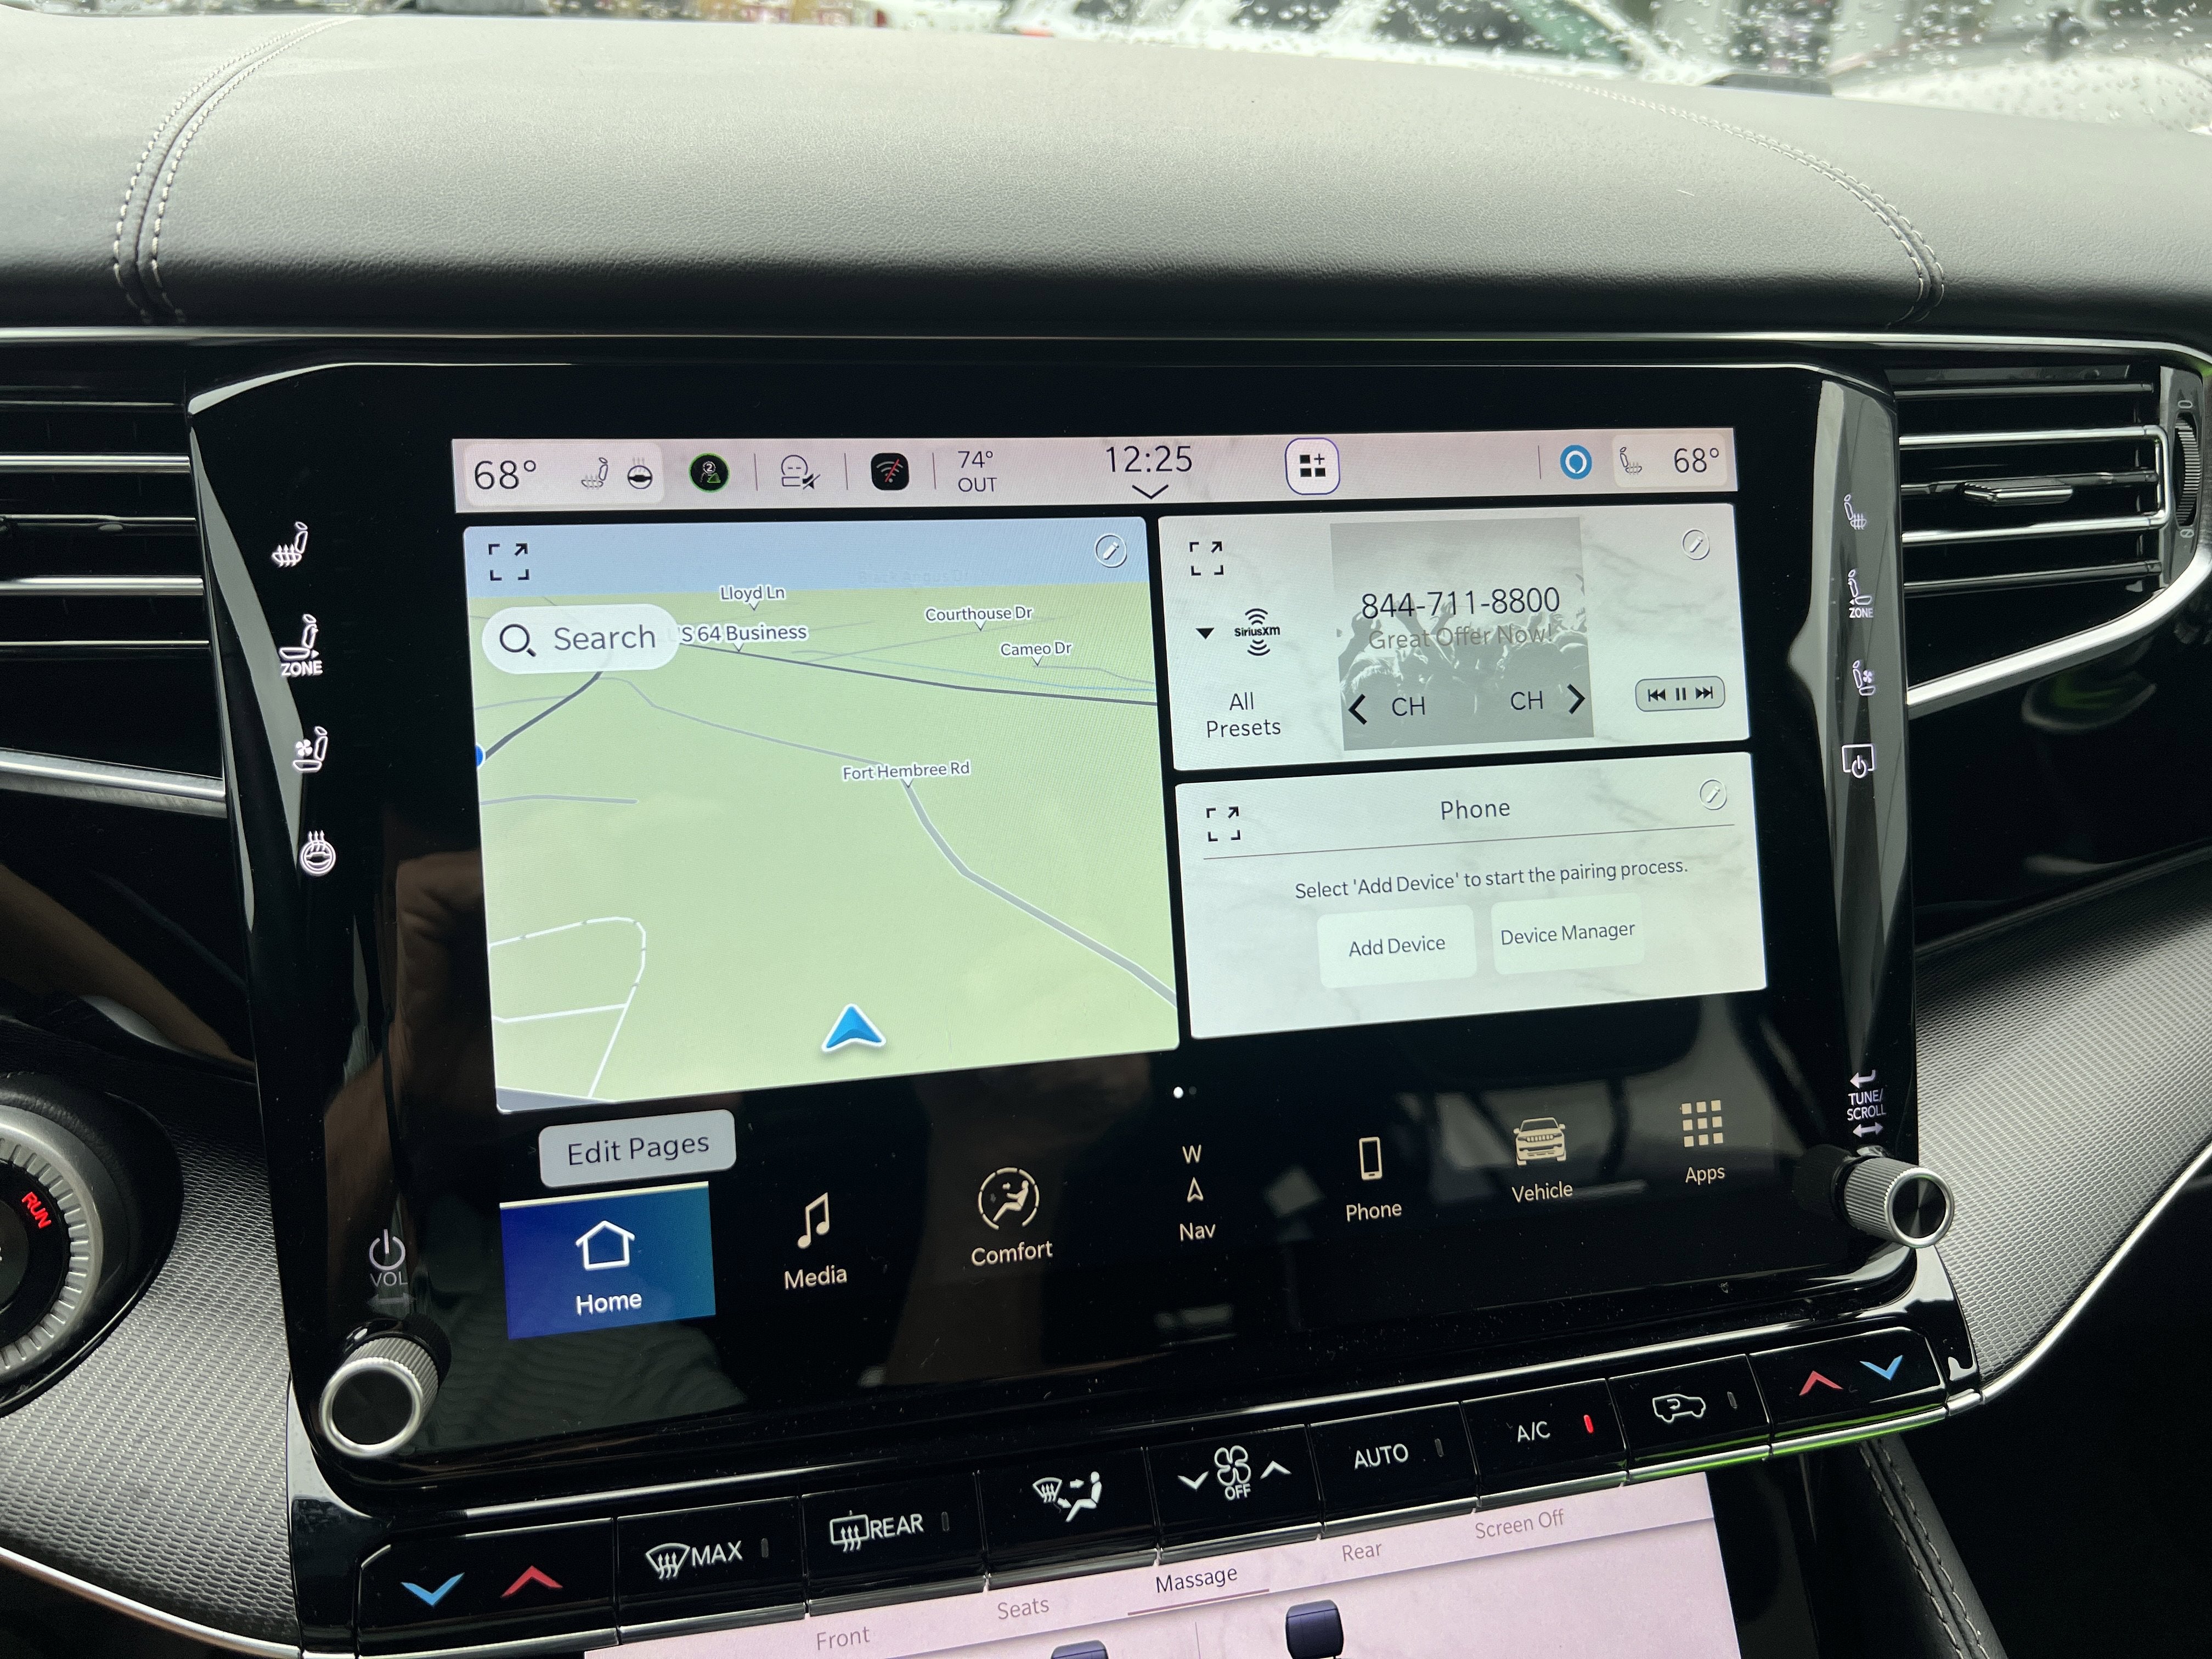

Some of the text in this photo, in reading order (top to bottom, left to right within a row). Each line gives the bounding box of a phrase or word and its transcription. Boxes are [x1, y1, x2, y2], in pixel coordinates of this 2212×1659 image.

[957, 450, 994, 469] 74°
[1105, 445, 1193, 473] 12:25
[1673, 447, 1720, 473] 68°
[473, 460, 537, 490] 68°
[957, 476, 997, 493] OUT
[720, 585, 785, 602] Lloyd Ln
[1361, 586, 1560, 619] 844-711-8800
[926, 606, 1032, 622] Courthouse Dr
[1849, 607, 1874, 618] ZONE
[554, 624, 656, 651] Search
[697, 625, 721, 642] 64
[727, 624, 807, 641] Business
[1368, 623, 1553, 650] Great Offer Now!
[1000, 641, 1072, 656] Cameo Dr
[280, 660, 323, 676] ZONE
[1229, 691, 1254, 710] All
[1391, 697, 1426, 716] CH
[1510, 691, 1544, 711] CH
[1206, 719, 1281, 738] Presets
[843, 761, 969, 780] Fort Hembree Rd
[1441, 799, 1510, 820] Phone
[1295, 881, 1349, 899] Select
[1464, 872, 1481, 887] to
[1485, 870, 1525, 886] start
[1528, 866, 1555, 883] the
[1560, 863, 1616, 884] pairing
[1621, 861, 1689, 879] process.
[1500, 923, 1635, 946] Device Manager
[1349, 935, 1446, 958] Add Device
[1848, 1088, 1883, 1105] TUNE/
[1847, 1104, 1887, 1121] SCROLL
[568, 1135, 710, 1167] Edit Pages
[1685, 1166, 1726, 1185] Apps
[1511, 1181, 1573, 1203] Vehicle
[21, 1191, 52, 1229] RUN
[1345, 1200, 1402, 1222] Phone
[1179, 1222, 1216, 1241] Nav
[970, 1240, 1053, 1267] Comfort
[369, 1272, 408, 1286] VOL
[783, 1266, 848, 1291] Media
[576, 1293, 642, 1316] Home
[1517, 1420, 1551, 1442] A/C
[1353, 1443, 1409, 1469] AUTO
[1224, 1483, 1251, 1500] OFF
[870, 1513, 924, 1539] REAR
[1475, 1508, 1565, 1540] Screen Off
[691, 1541, 743, 1567] MAX
[1341, 1541, 1383, 1562] Rear
[1155, 1564, 1238, 1594] Massage
[997, 1595, 1050, 1621] Seats
[816, 1626, 870, 1651] Front
